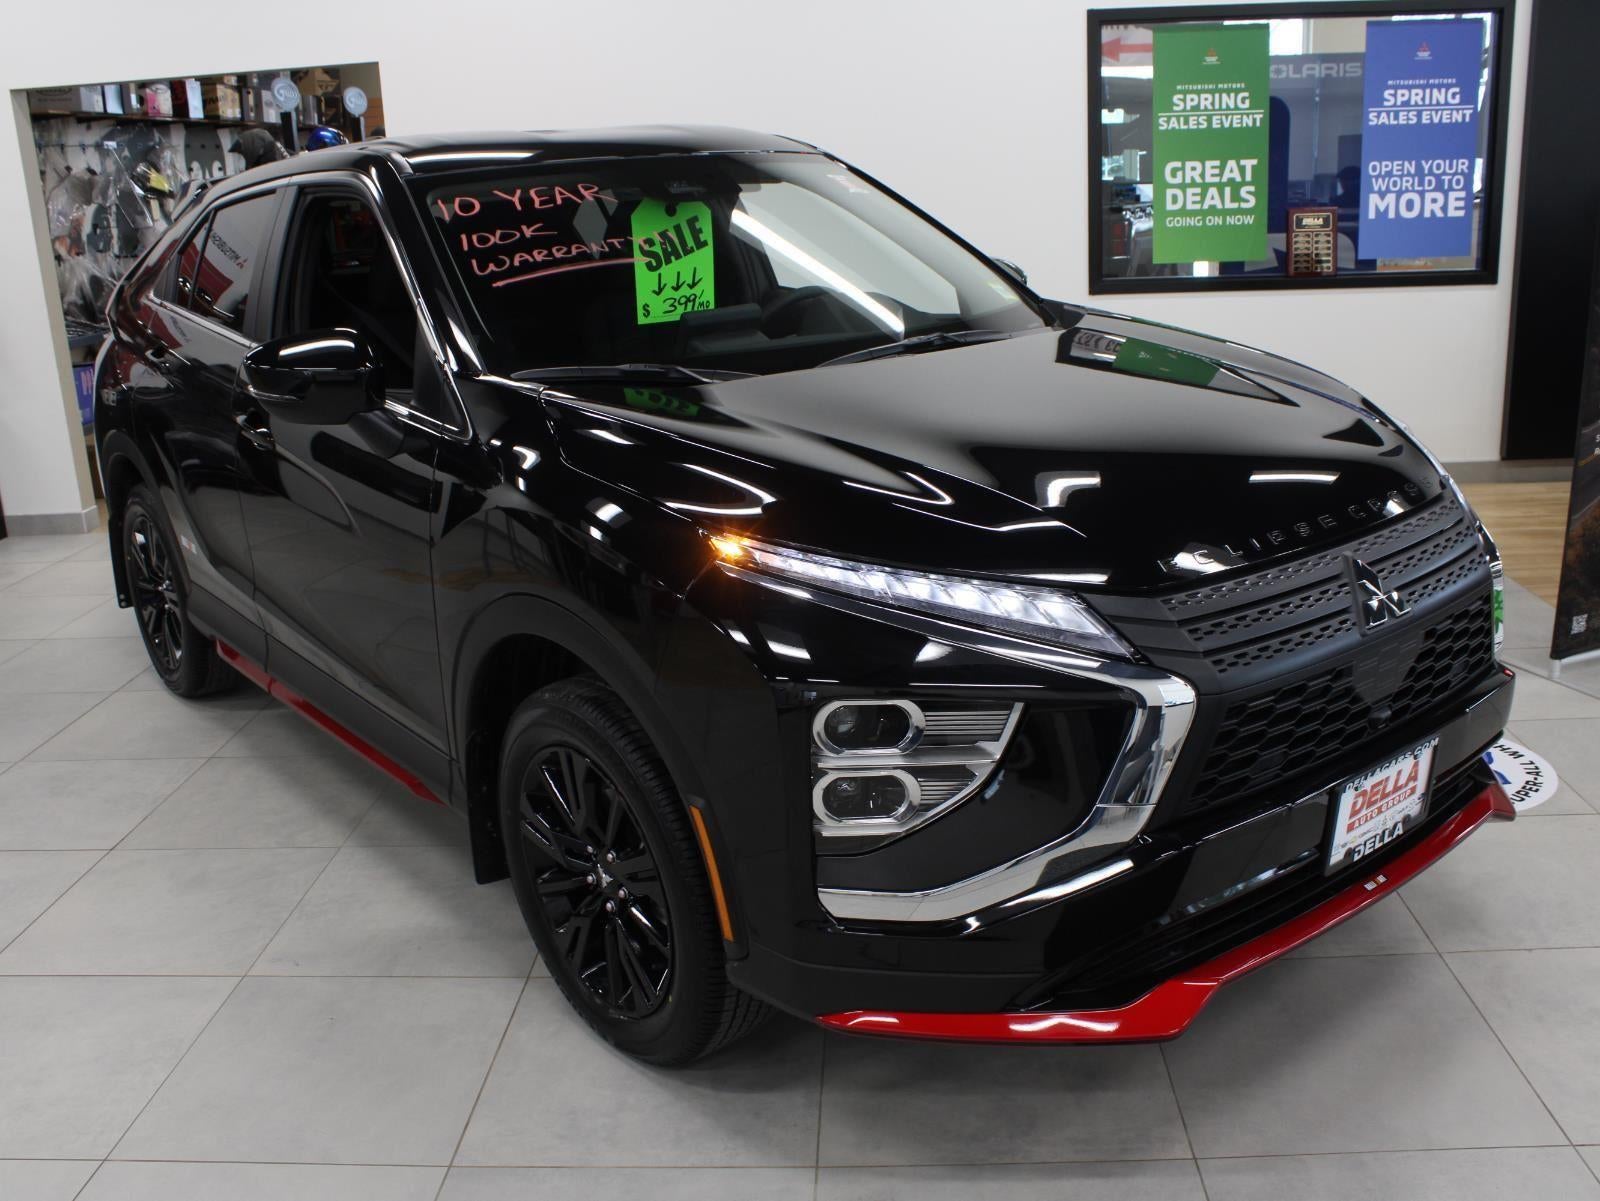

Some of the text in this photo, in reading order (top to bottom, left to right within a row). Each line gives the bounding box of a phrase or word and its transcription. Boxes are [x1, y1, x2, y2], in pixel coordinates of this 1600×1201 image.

[1269, 63, 1362, 79] OLARIS
[1172, 92, 1250, 111] SPRING
[1383, 87, 1460, 106] SPRING
[1158, 114, 1264, 130] SALES EVENT
[1368, 109, 1474, 125] SALES EVENT
[1164, 159, 1258, 184] GREAT
[1368, 159, 1469, 176] OPEN YOUR
[1372, 175, 1465, 191] WORLD TO
[436, 183, 618, 224] 10 YEAR
[1165, 185, 1256, 211] DEALS
[1368, 191, 1466, 219] MORE
[1166, 215, 1255, 228] GOING ON NOW
[460, 223, 558, 252] 100K
[638, 215, 709, 272] SALE
[1349, 759, 1420, 820] DELLA
[1510, 760, 1544, 804] UPER-ALL
[1353, 806, 1378, 829] AUTO
[1381, 789, 1412, 813] GROUP
[1353, 821, 1404, 862] DELLA
